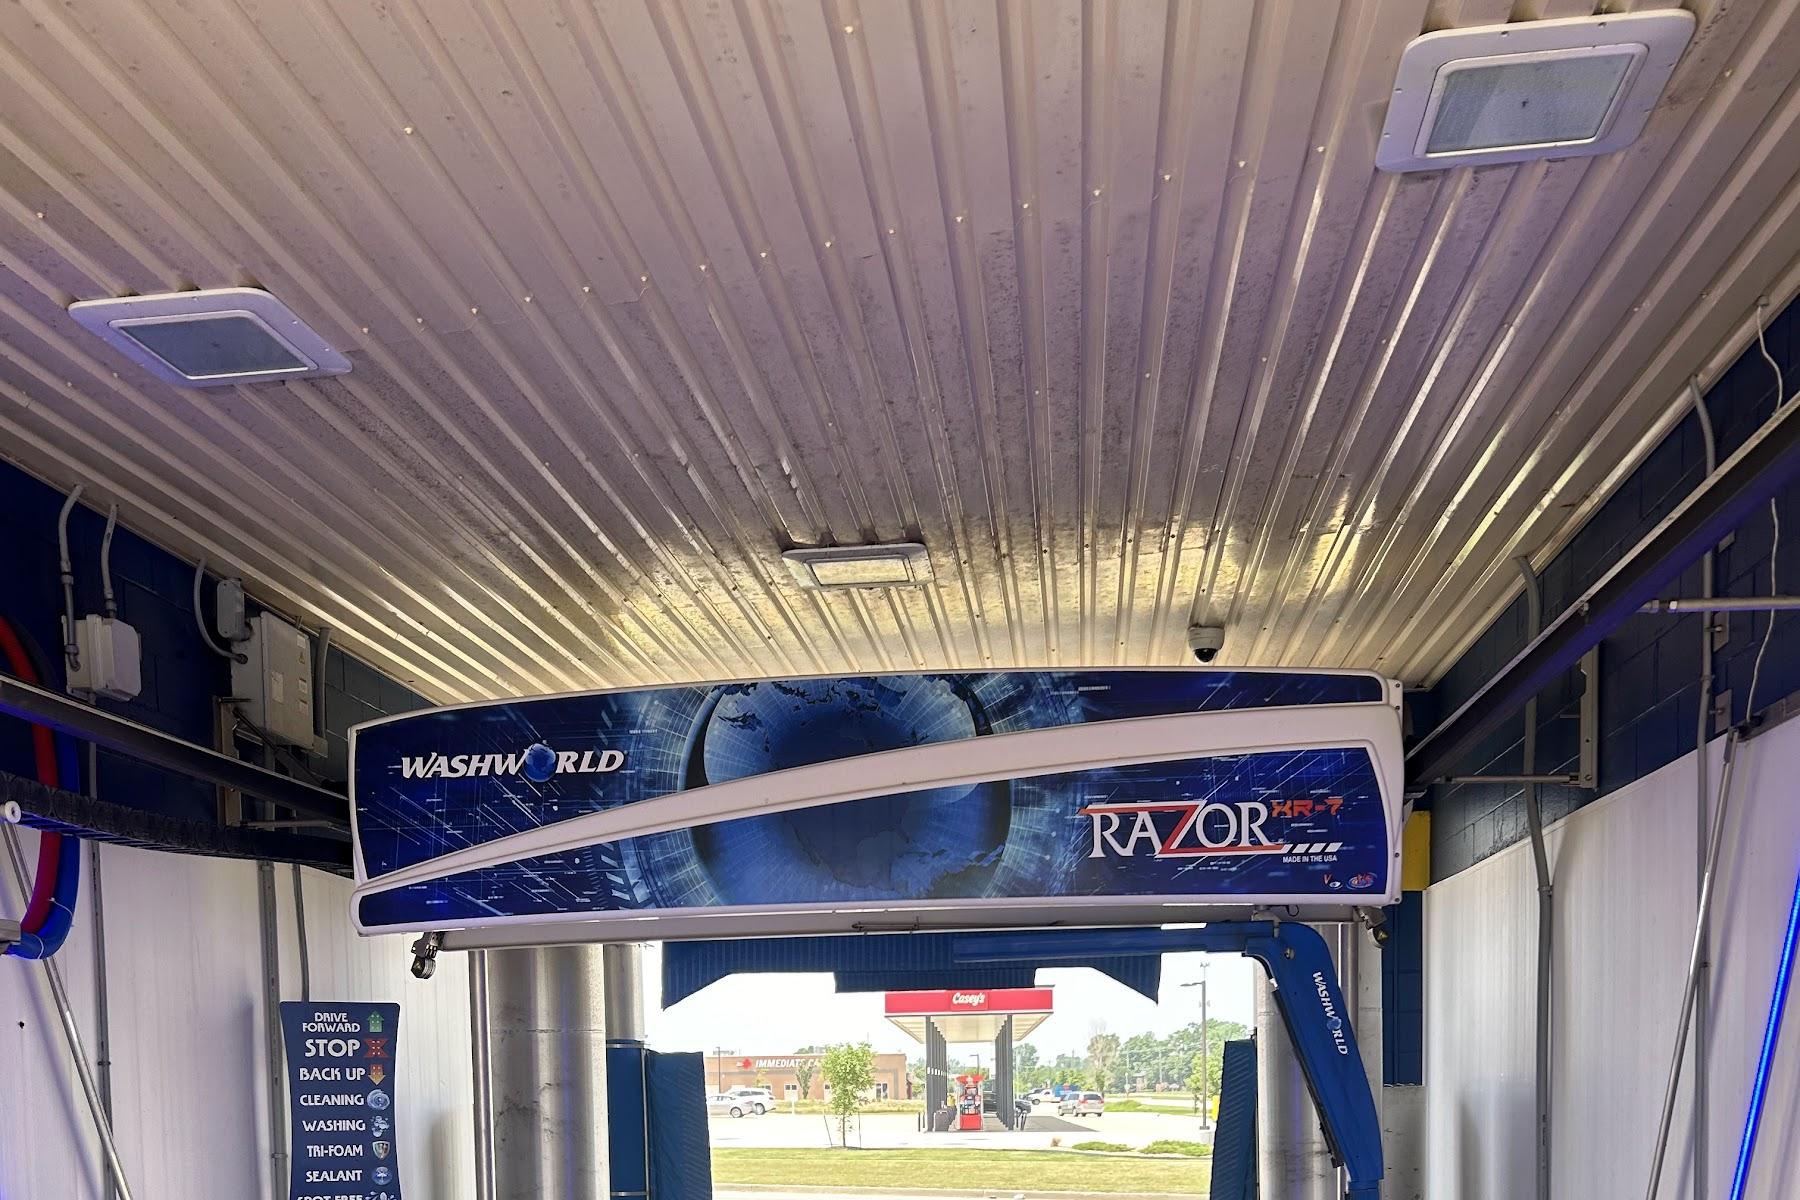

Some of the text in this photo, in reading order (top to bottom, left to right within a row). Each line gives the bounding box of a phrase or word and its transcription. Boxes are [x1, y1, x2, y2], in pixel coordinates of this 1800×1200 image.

[401, 742, 625, 783] WASHWORLD
[1077, 796, 1344, 859] RAZOR XR-7
[952, 992, 986, 1006] Casey's
[314, 1012, 348, 1022] DRIVE
[1312, 971, 1348, 1055] WASHWORLD
[302, 1022, 361, 1033] FORWARD
[304, 1039, 361, 1058] STOP
[299, 1068, 366, 1081] BACK UP
[299, 1095, 365, 1106] CLEANING
[302, 1120, 366, 1132] WASHING
[307, 1145, 363, 1157] TRI-FOAM
[305, 1170, 363, 1182] SEALANT
